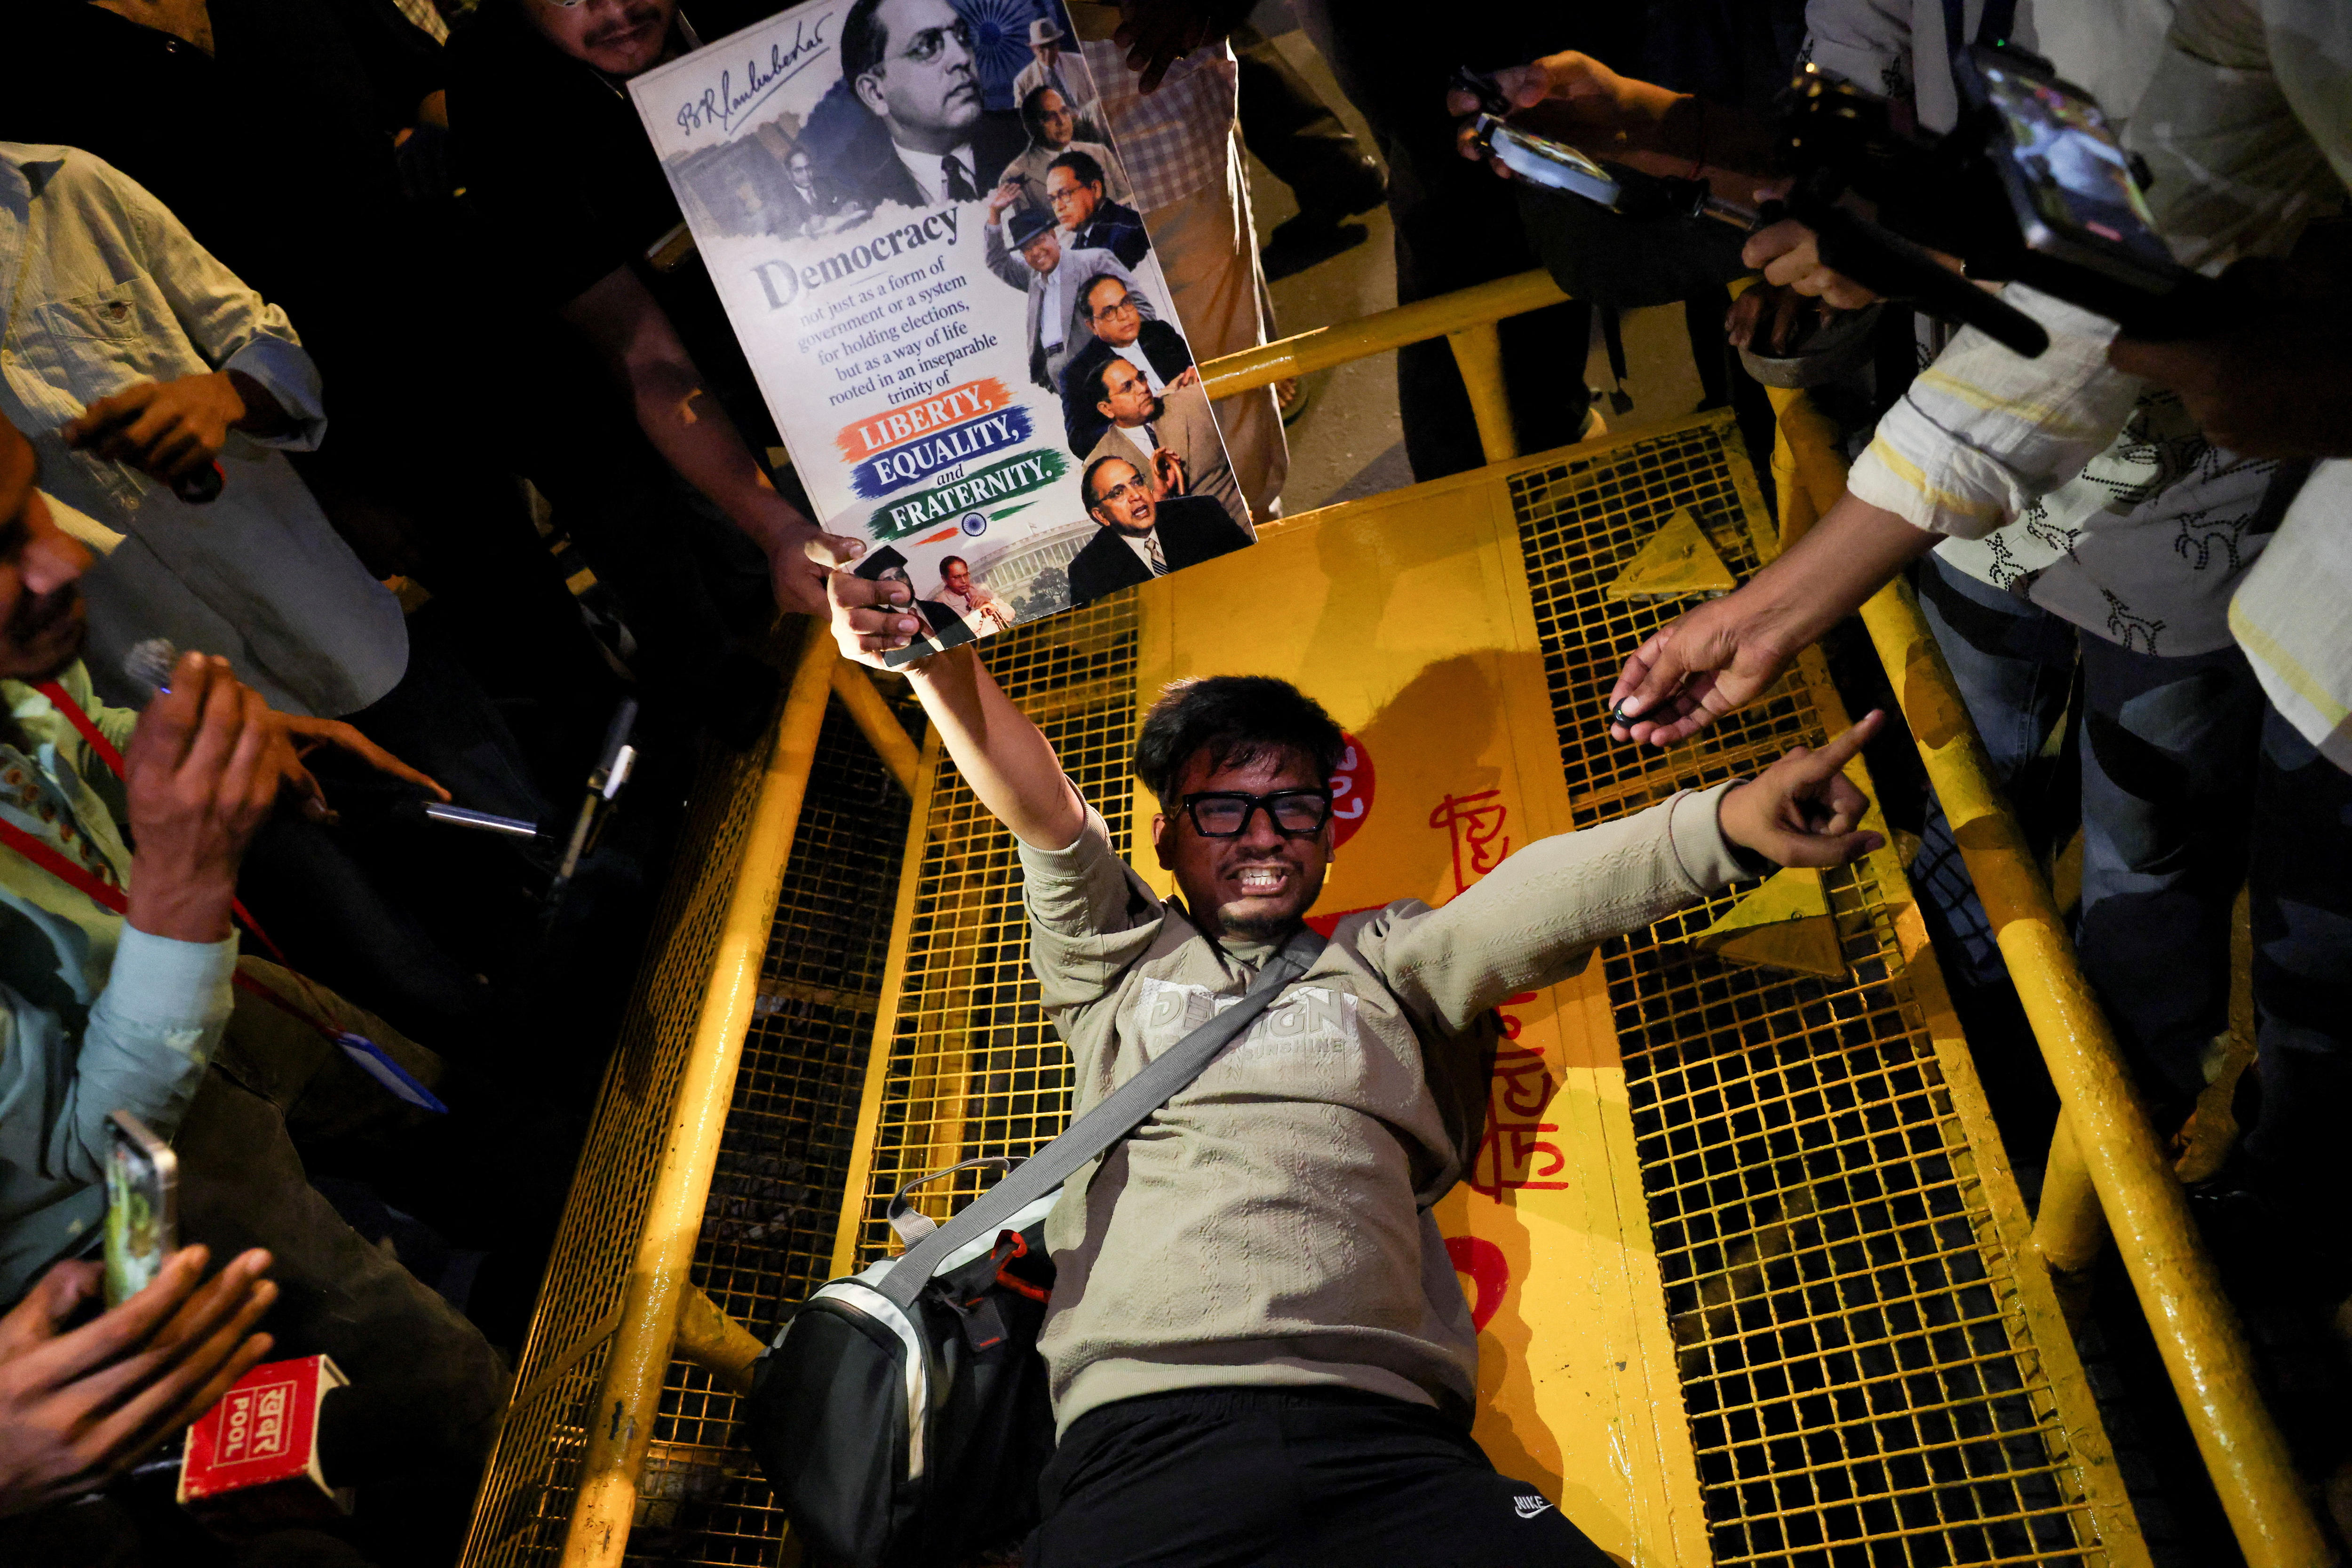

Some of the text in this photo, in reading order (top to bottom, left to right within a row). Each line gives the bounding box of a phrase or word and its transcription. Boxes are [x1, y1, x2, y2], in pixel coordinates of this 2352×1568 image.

[751, 206, 959, 313] Democracy
[800, 255, 946, 327] not just as a form of
[797, 275, 968, 354] government or a system
[817, 303, 970, 366] for holding elections,
[829, 333, 998, 406] rooted in an inseparable
[835, 321, 968, 381] but as a way of life
[858, 385, 993, 451] LIBERTY,
[887, 370, 951, 406] trinity of
[873, 414, 1019, 485] EQUALITY,
[937, 464, 964, 486] and
[887, 456, 1053, 531] FRATERNITY.
[1149, 988, 1347, 1041] DEIGN
[225, 1397, 250, 1458] POOL
[254, 1387, 286, 1454] खबर
[1514, 1496, 1543, 1510] NIKE
